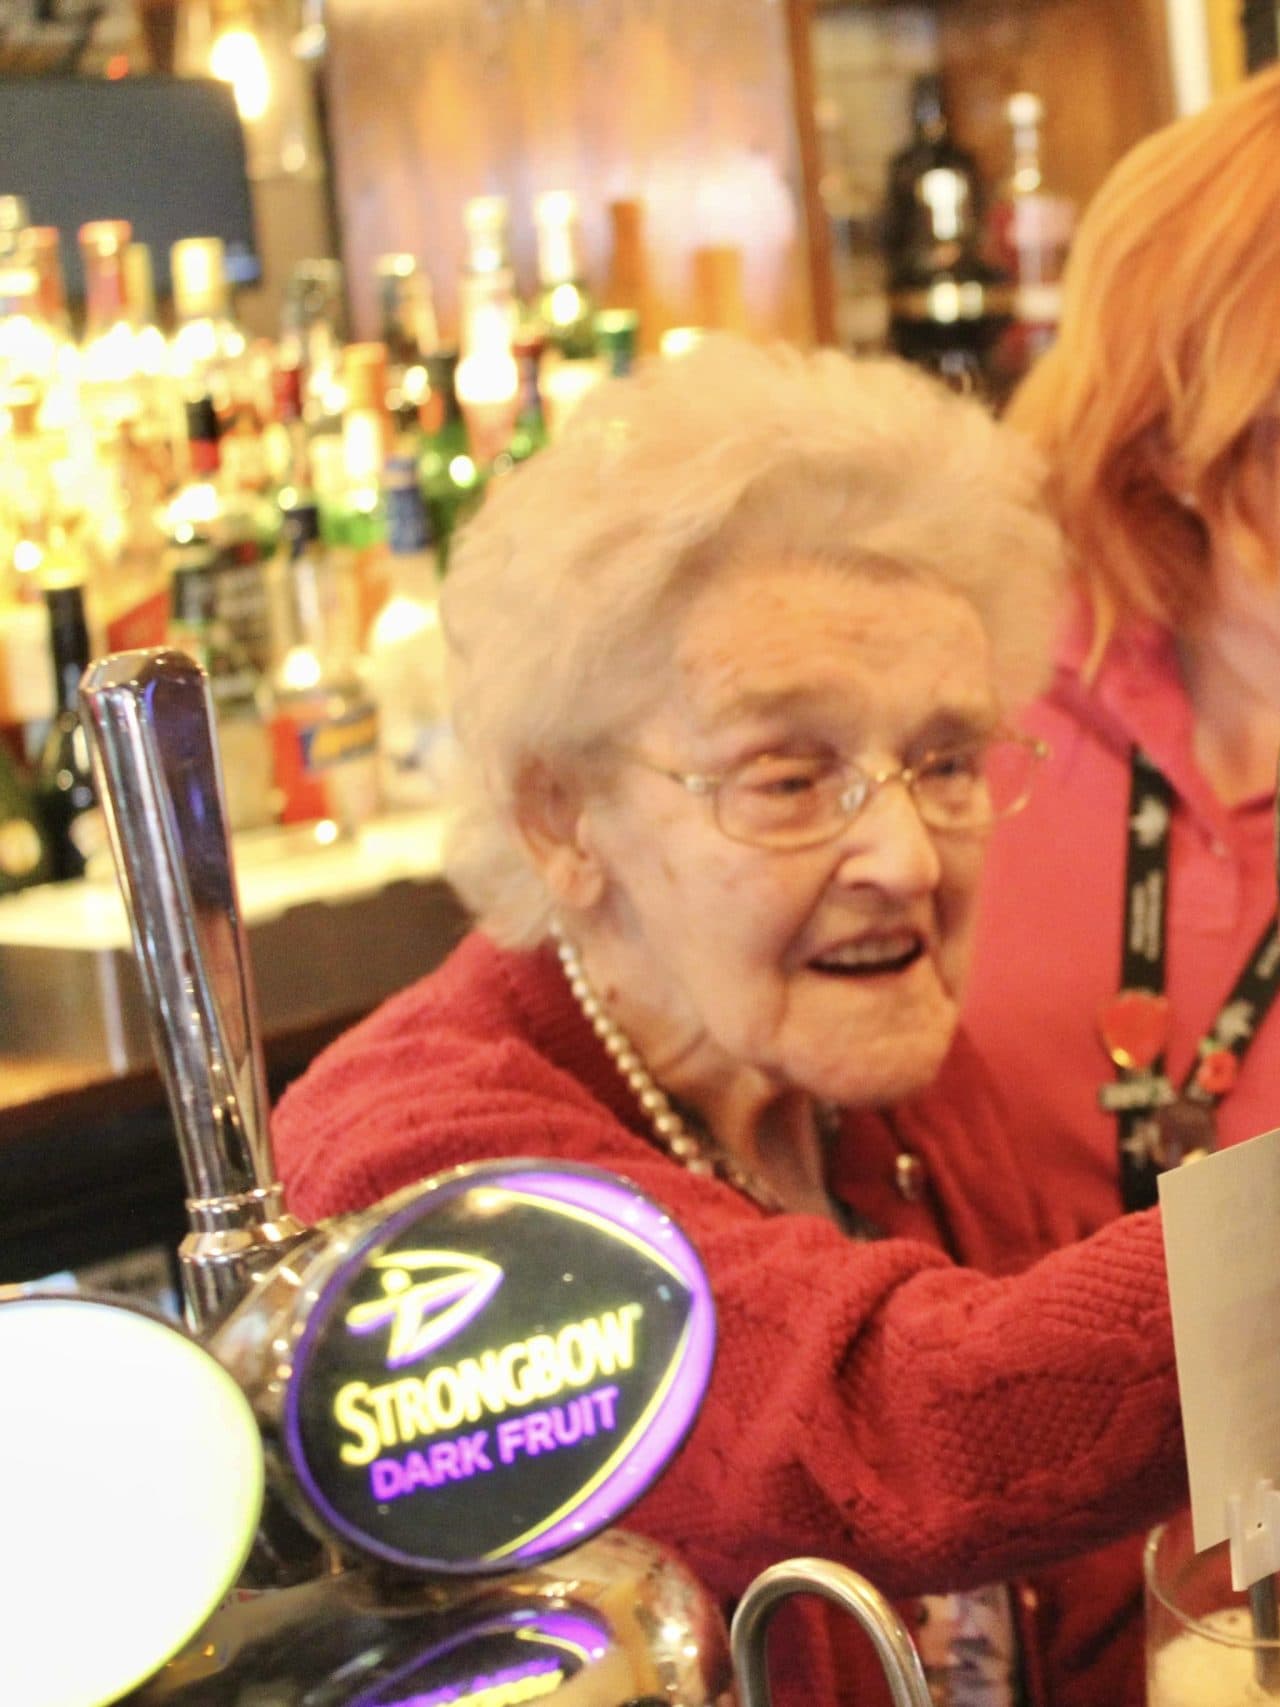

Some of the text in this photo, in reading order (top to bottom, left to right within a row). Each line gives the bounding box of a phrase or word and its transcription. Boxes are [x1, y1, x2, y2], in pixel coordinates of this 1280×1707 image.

[334, 1306, 636, 1466] STRONGBOW
[371, 1384, 619, 1500] DARK FRUIT
